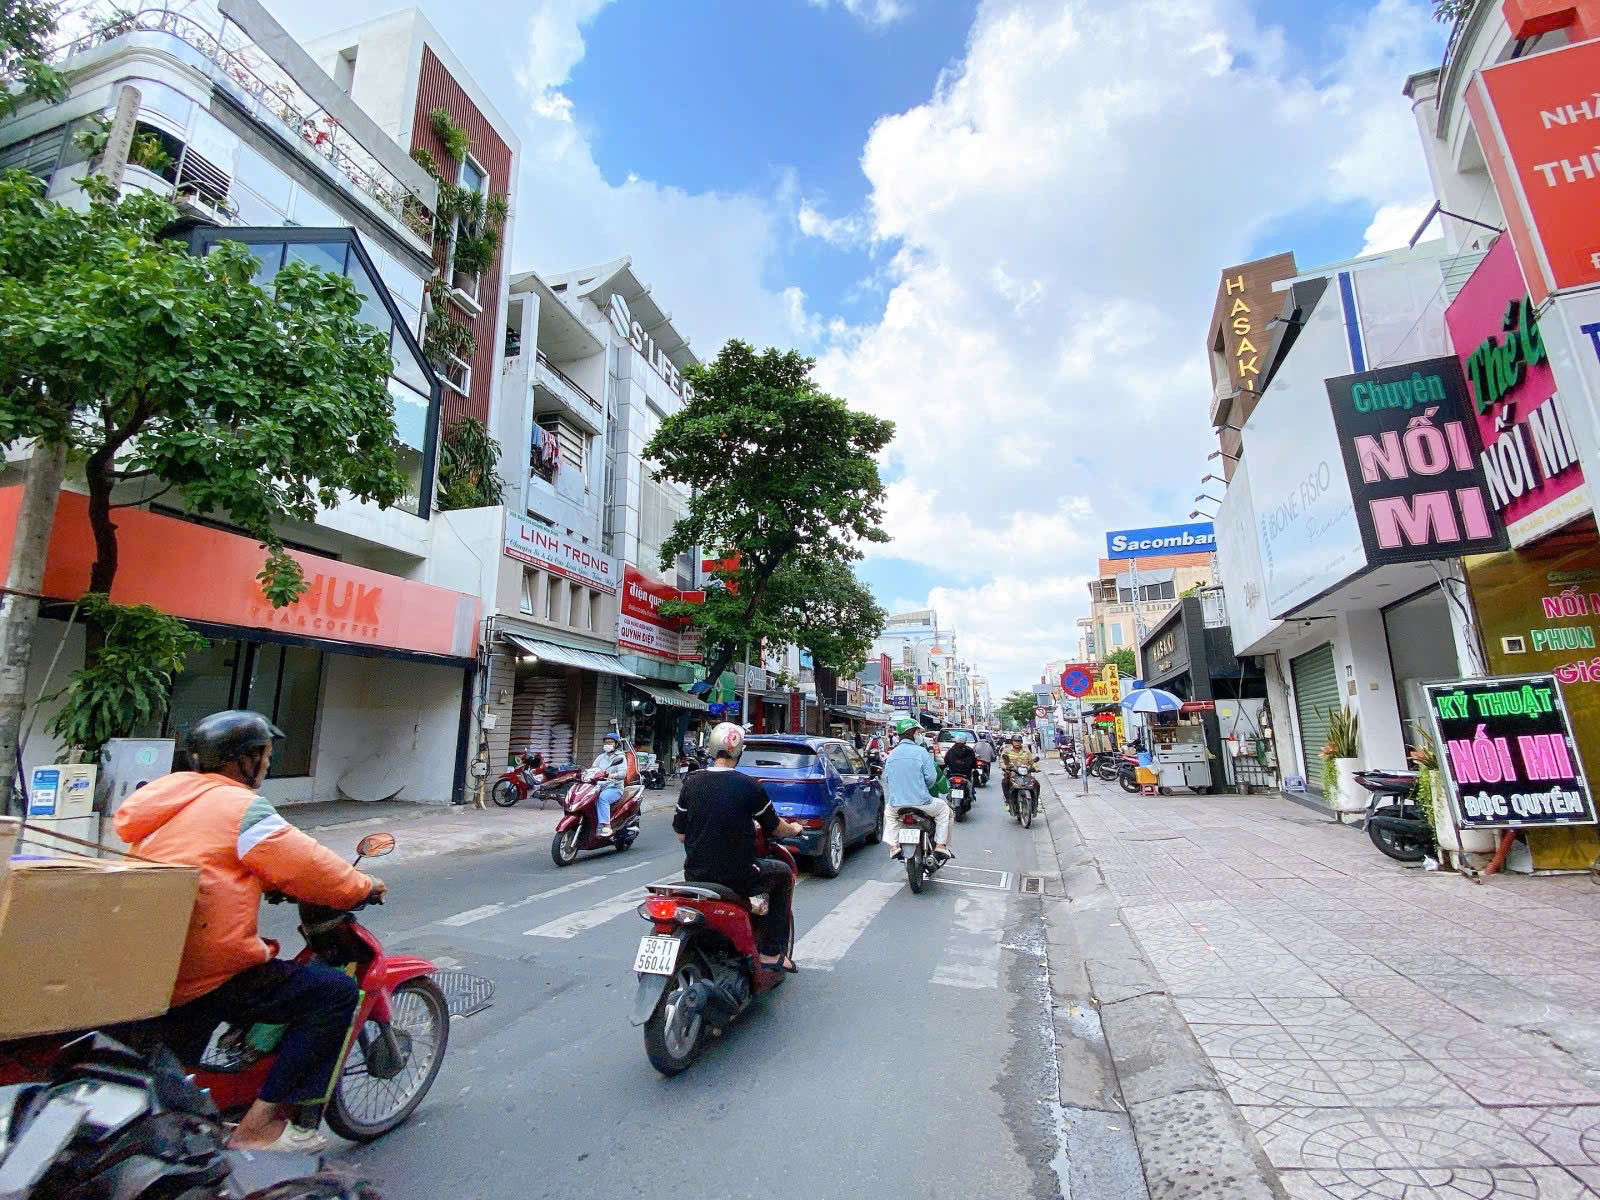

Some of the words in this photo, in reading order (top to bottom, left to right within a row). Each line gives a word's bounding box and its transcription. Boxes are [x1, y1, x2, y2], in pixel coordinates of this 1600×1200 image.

[1226, 275, 1259, 391] HASAKI
[1351, 372, 1447, 413] Chuyên
[1354, 406, 1474, 484] NỐI
[1480, 404, 1536, 511] NỐI
[1528, 391, 1579, 479] MI
[1369, 487, 1492, 549] MI
[520, 525, 559, 553] LINH
[563, 544, 609, 574] TRỌNG
[627, 581, 648, 602] điện
[1542, 586, 1588, 618] NỐI
[621, 625, 641, 641] QUỲNH
[642, 632, 654, 646] ĐIỆP
[1531, 626, 1595, 651] PHUN
[1437, 691, 1469, 719] KỸ
[1474, 685, 1553, 718] THUẬT
[1448, 723, 1516, 784] NỐI
[1518, 734, 1574, 780] MI
[1464, 790, 1508, 821] ĐỘC
[638, 954, 670, 972] 560.44
